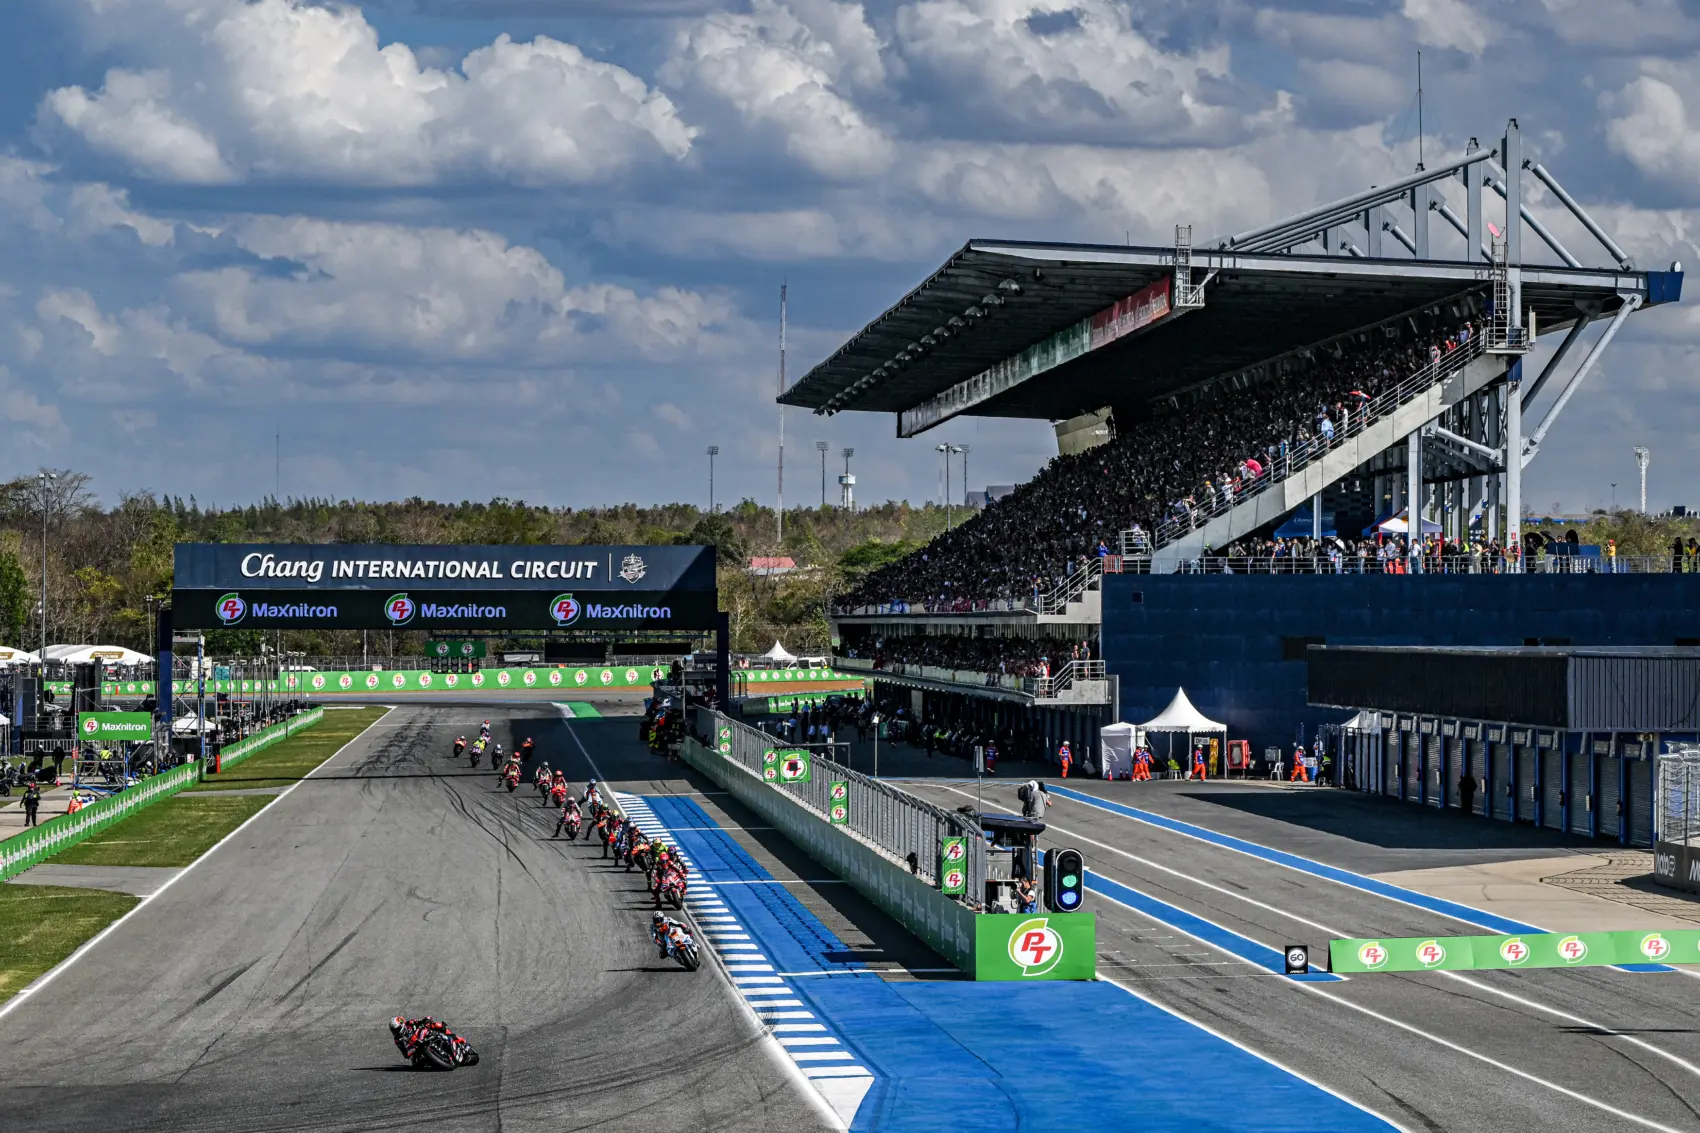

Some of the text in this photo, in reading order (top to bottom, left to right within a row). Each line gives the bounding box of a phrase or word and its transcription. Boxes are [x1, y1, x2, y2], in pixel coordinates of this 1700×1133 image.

[240, 552, 598, 583] Chang INTERNATIONAL CIRCUIT
[1021, 932, 1052, 964] PT
[1290, 953, 1304, 962] 60
